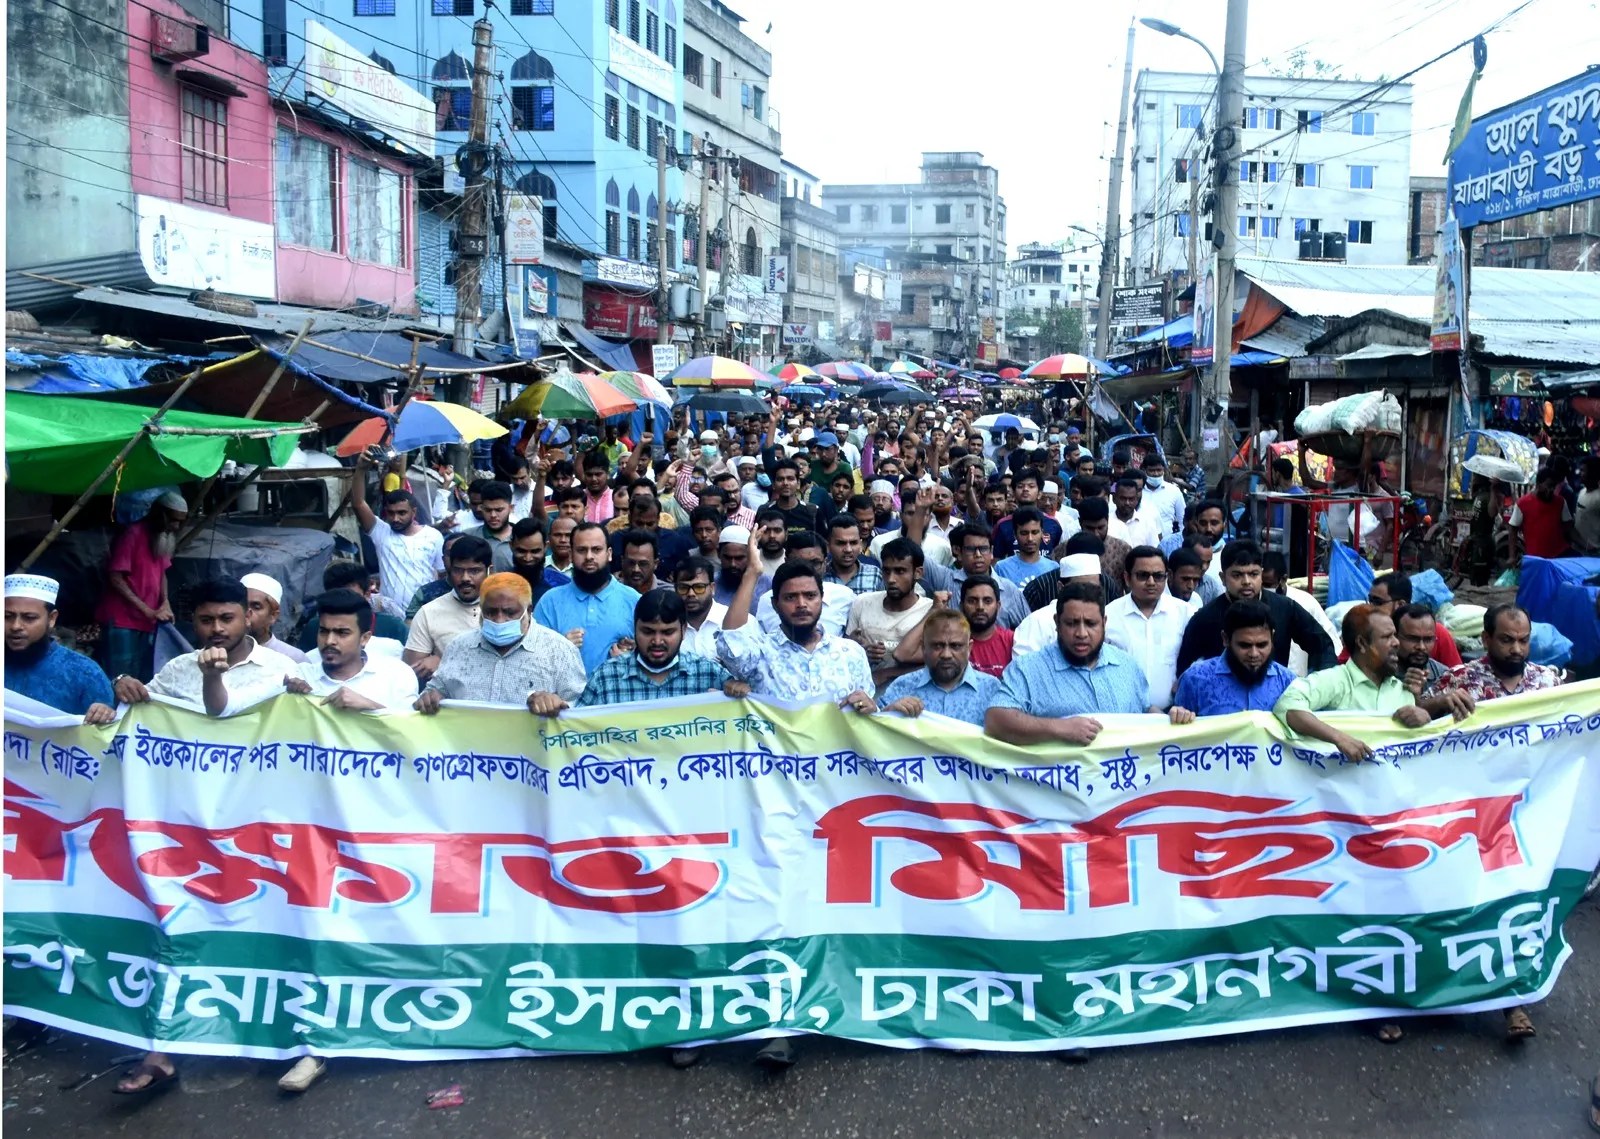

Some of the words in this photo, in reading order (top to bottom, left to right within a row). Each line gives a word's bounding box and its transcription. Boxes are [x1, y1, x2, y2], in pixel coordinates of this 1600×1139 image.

[1454, 150, 1539, 207] যাত্রাবাড়ী
[1543, 143, 1587, 183] বড়
[469, 240, 484, 251] 28
[134, 723, 247, 773] ইন্তেকালের
[249, 742, 281, 772] পর
[287, 741, 406, 779] সারাদেশে
[412, 751, 551, 795] গণগ্রেফতারের
[677, 743, 819, 781] কেয়ারটেকার
[825, 750, 927, 785] সরকারের
[1157, 742, 1259, 776] নিরপেক্ষ
[1265, 742, 1284, 767] ও
[646, 716, 727, 741] রহমানির
[812, 789, 1525, 911] মিছিল
[106, 951, 483, 1035] জামায়াতে
[505, 949, 830, 1039] ইসলামী,
[856, 967, 1043, 1024] ঢাকা
[1066, 925, 1423, 1017] মহানগরী
